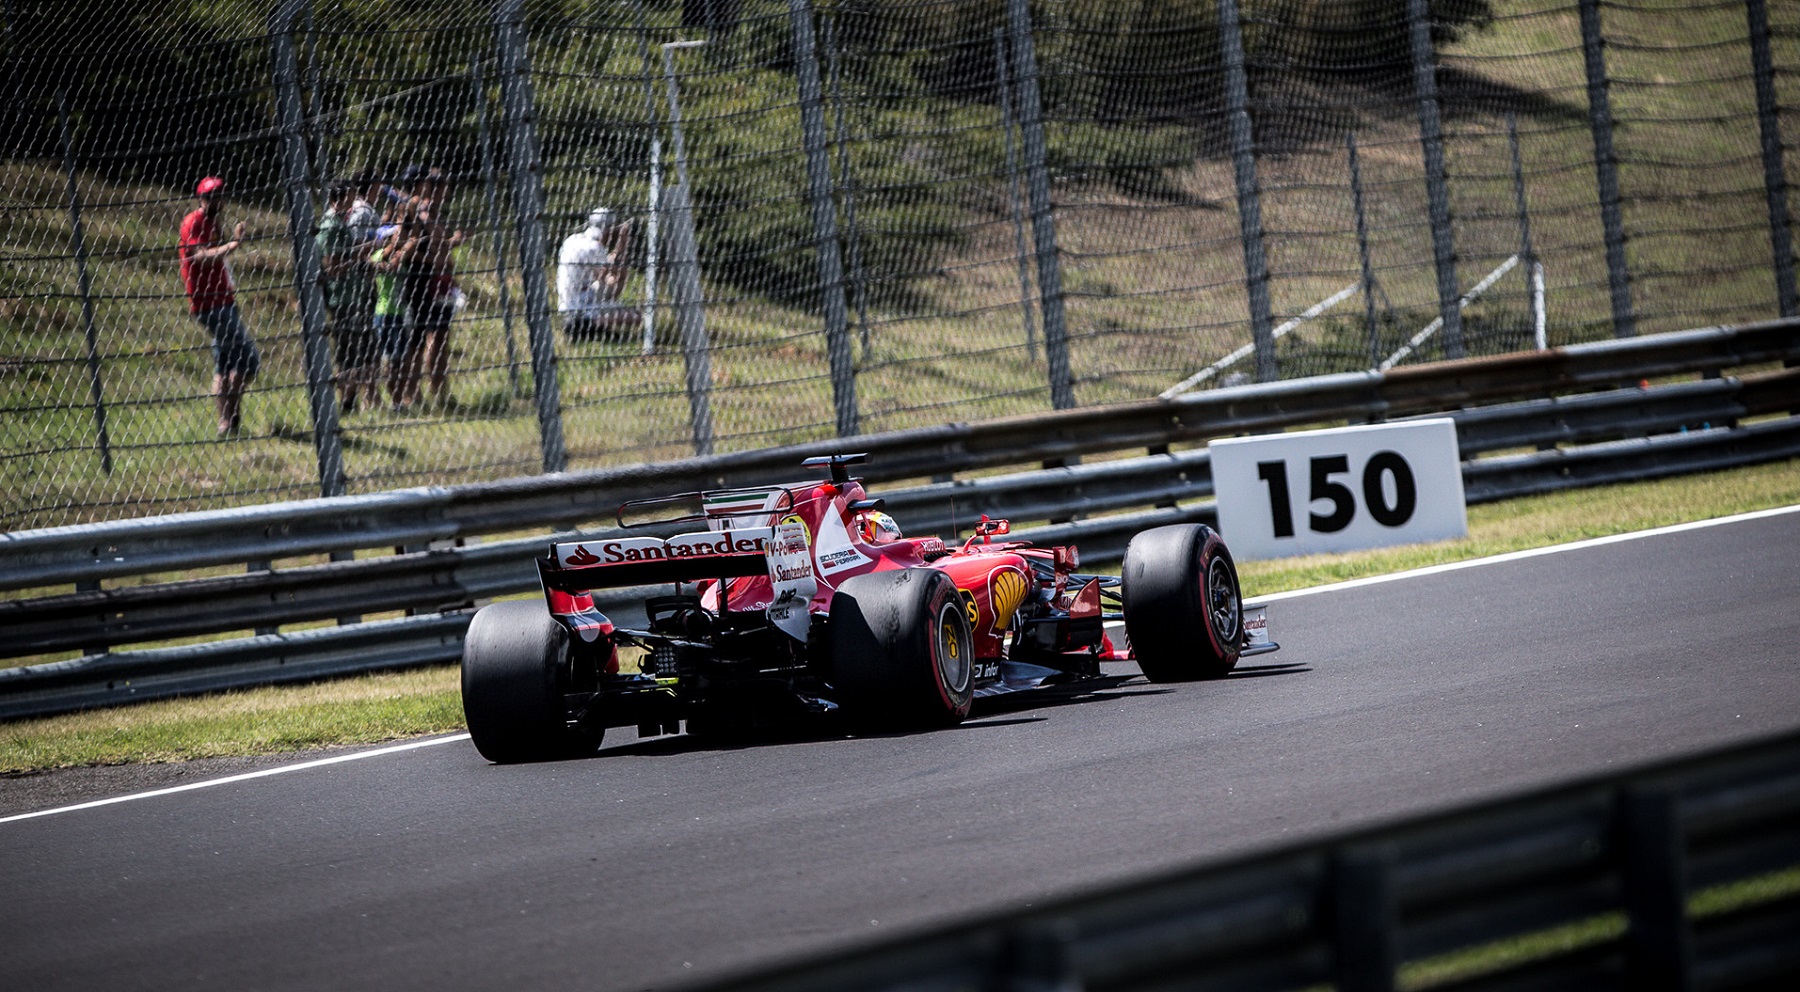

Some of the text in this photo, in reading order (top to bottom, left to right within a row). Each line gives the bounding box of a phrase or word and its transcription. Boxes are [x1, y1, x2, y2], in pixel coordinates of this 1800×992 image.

[1257, 450, 1417, 538] 150
[603, 532, 767, 563] Santander
[820, 550, 849, 562] SCUDERIA
[776, 559, 811, 582] Santander
[835, 555, 861, 566] FERRARI
